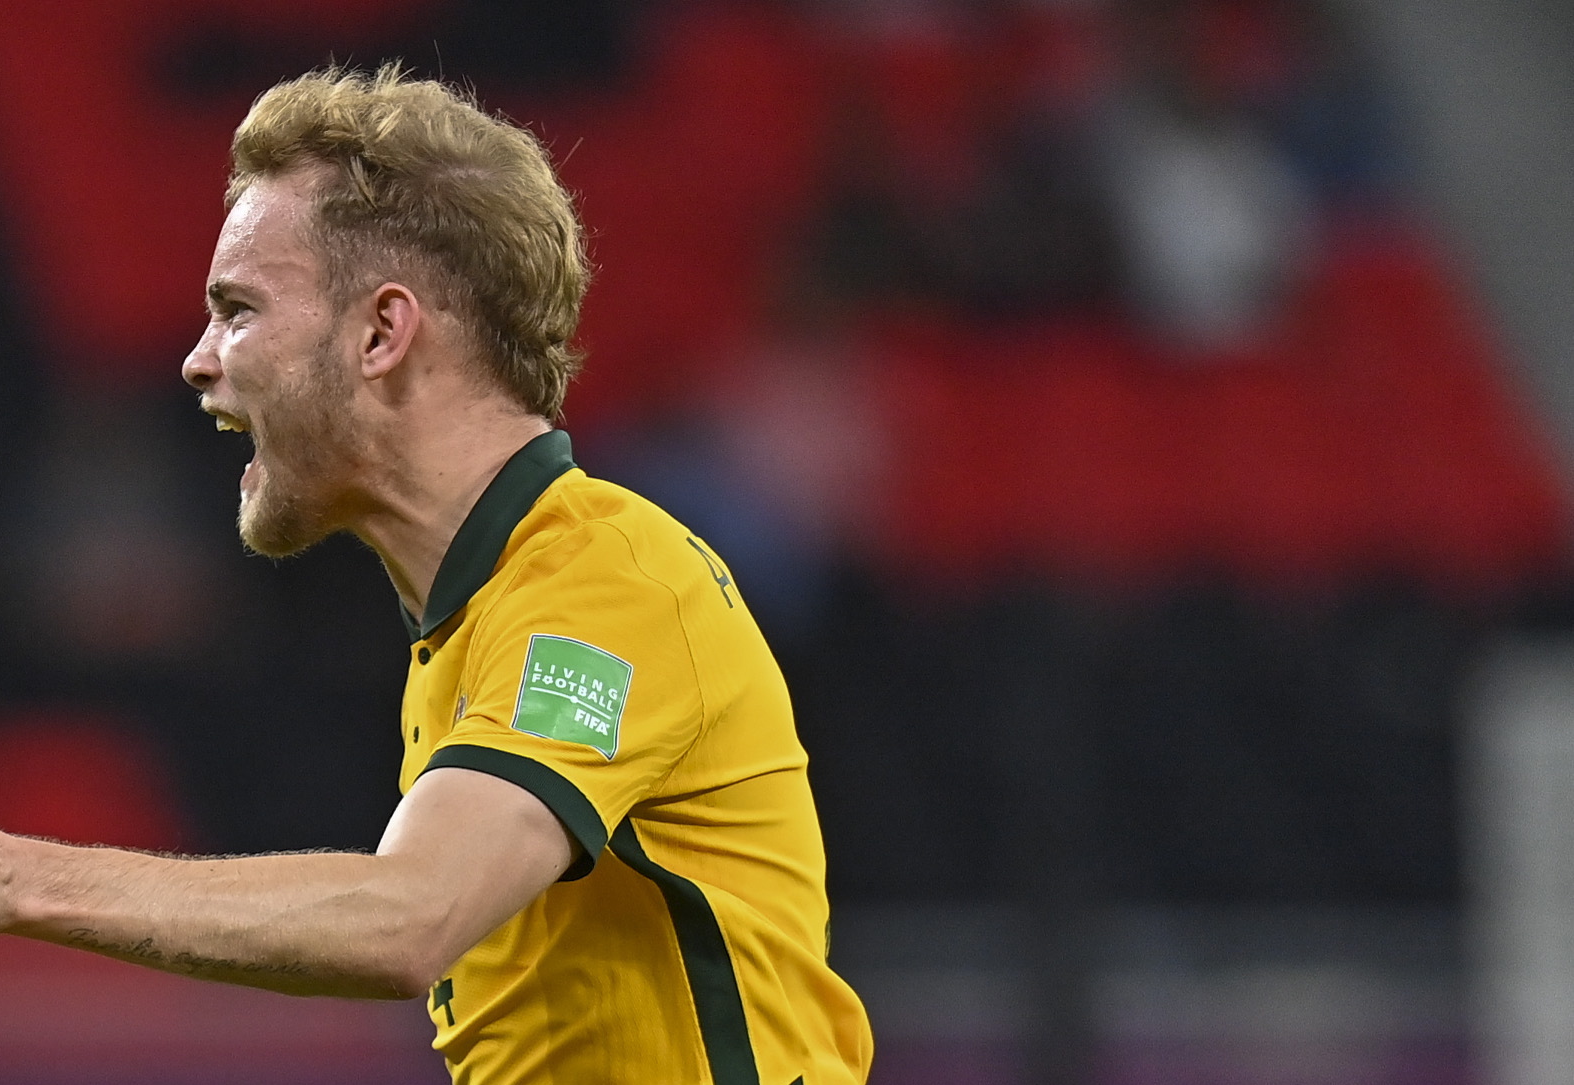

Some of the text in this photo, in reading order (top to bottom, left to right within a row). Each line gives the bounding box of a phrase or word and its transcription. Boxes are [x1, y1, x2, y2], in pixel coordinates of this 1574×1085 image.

[531, 673, 614, 712] FOOTBALL
[533, 662, 618, 700] LIVING
[574, 708, 610, 735] FIFA
